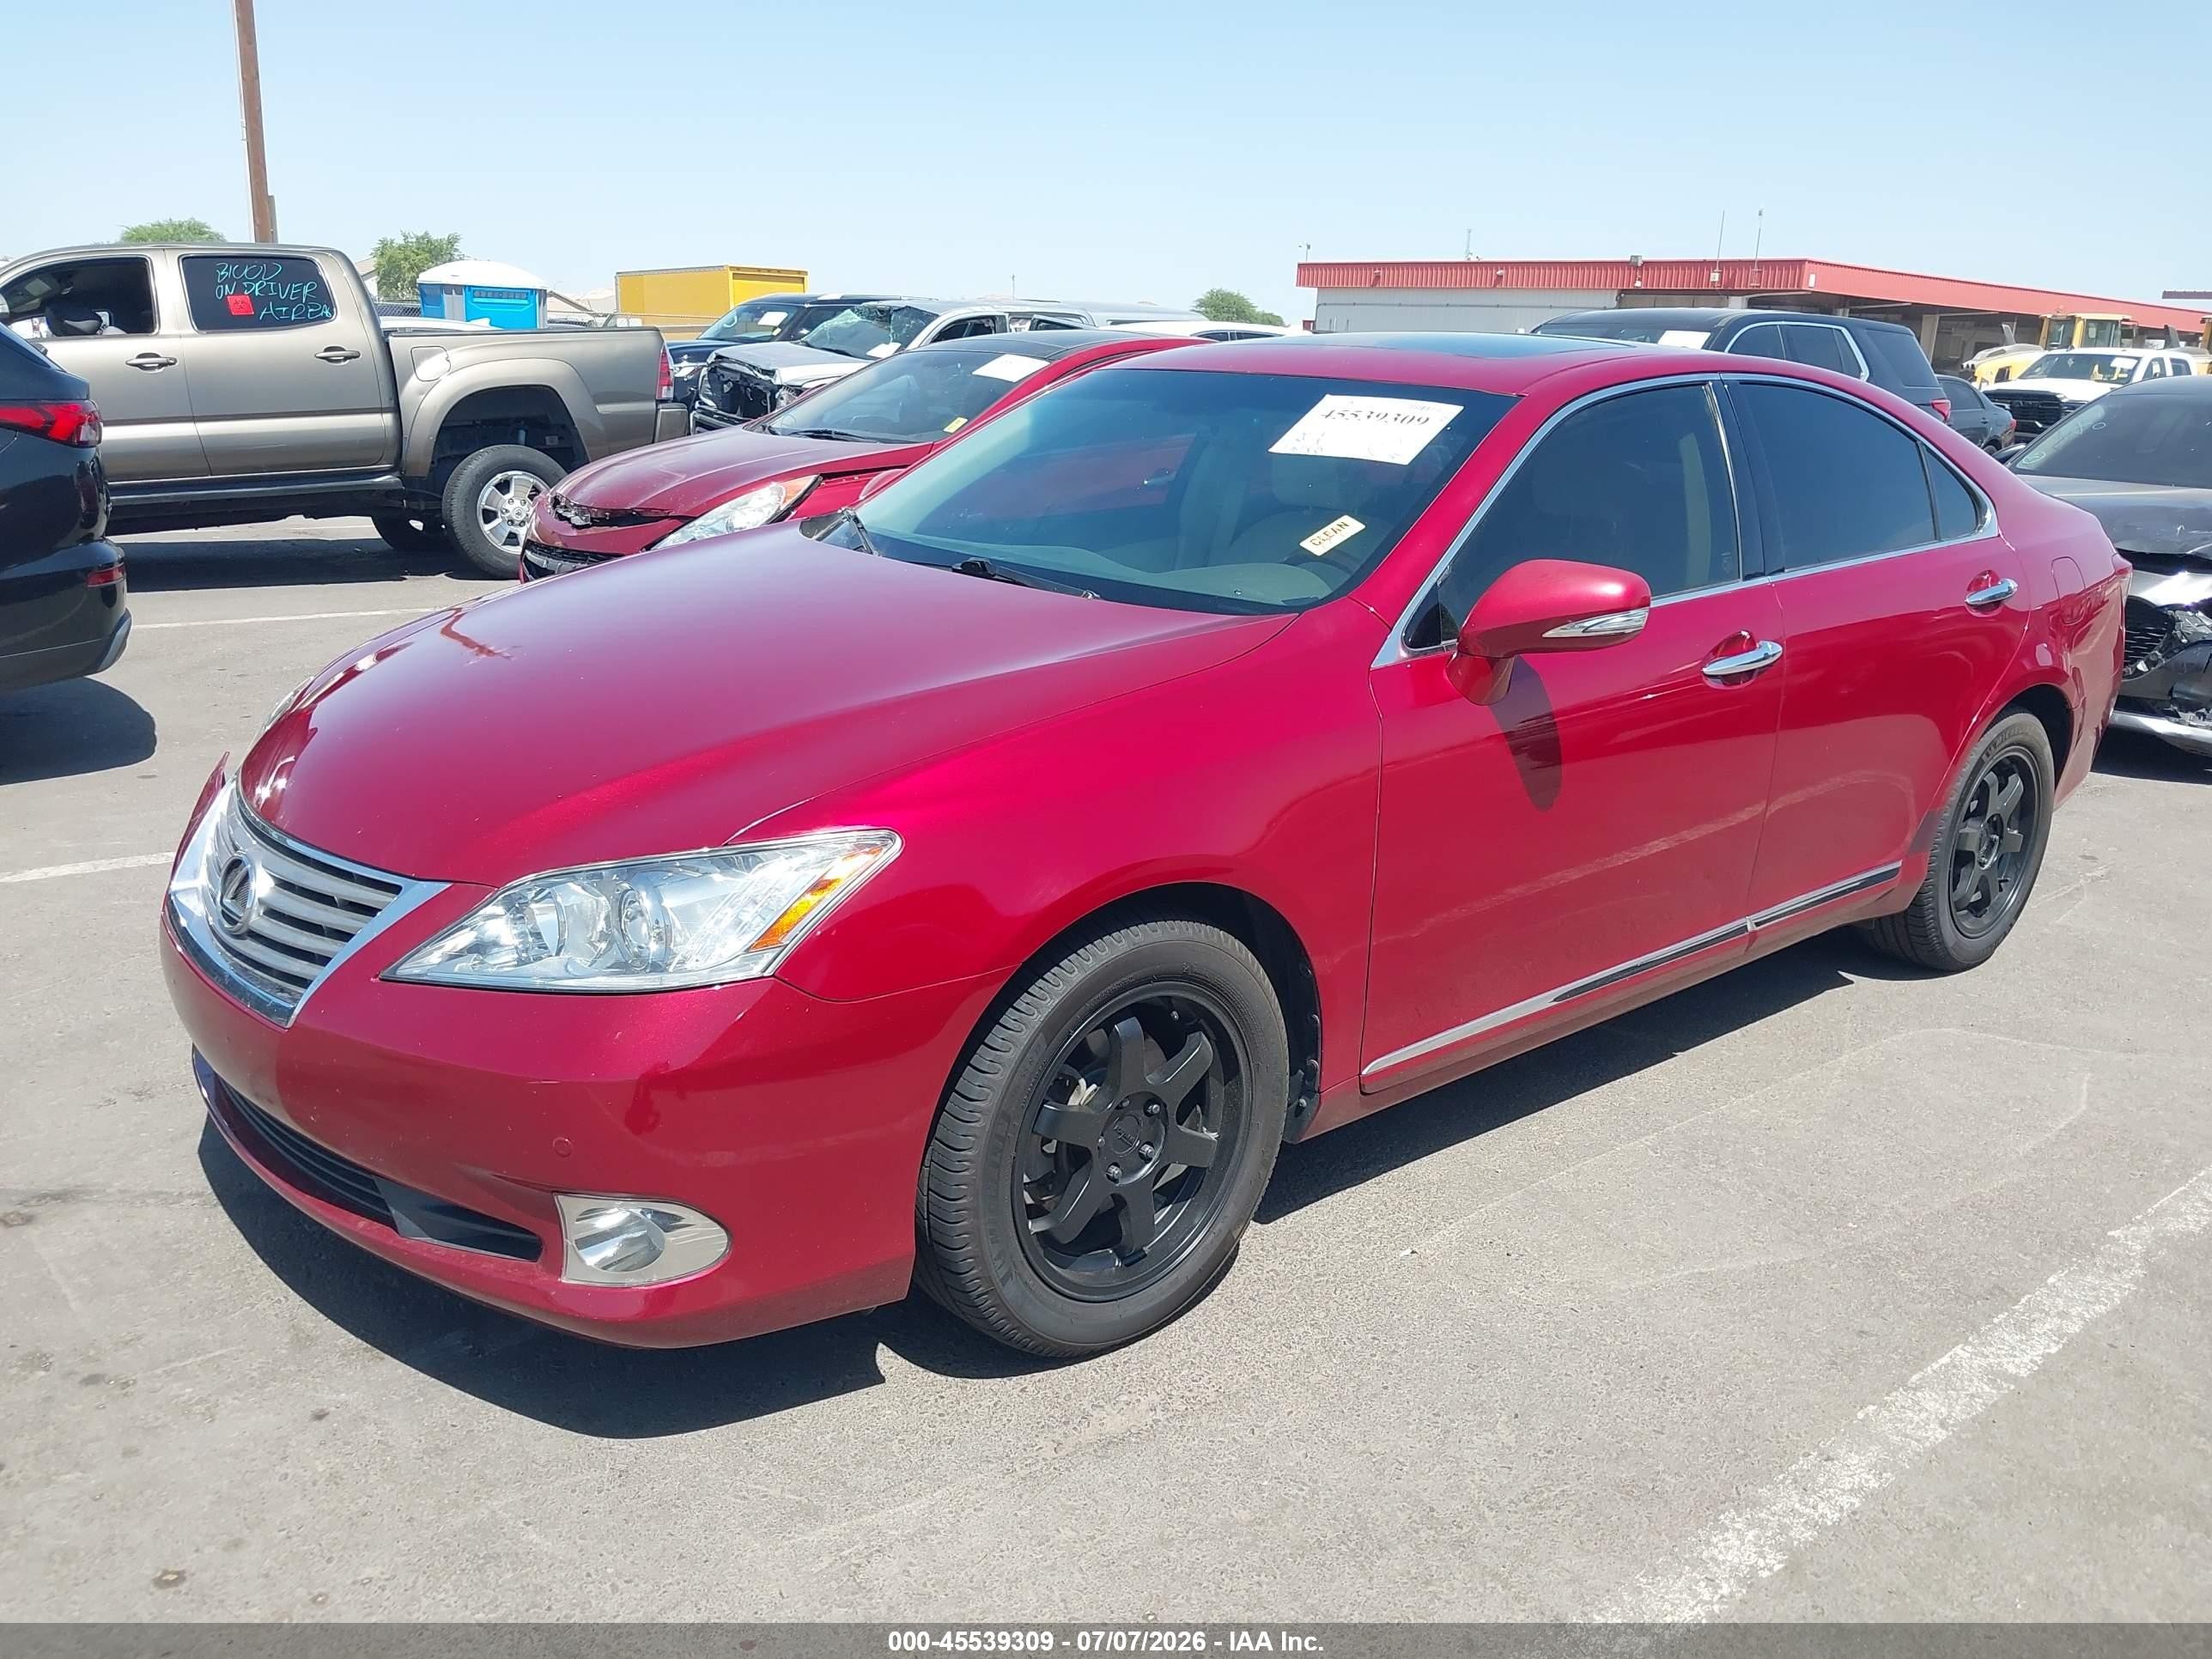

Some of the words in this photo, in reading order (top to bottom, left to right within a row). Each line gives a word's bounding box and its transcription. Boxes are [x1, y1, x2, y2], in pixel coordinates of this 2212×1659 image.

[216, 281, 236, 300] ON
[242, 281, 317, 302] DRIVER
[1310, 521, 1350, 546] CLEAN
